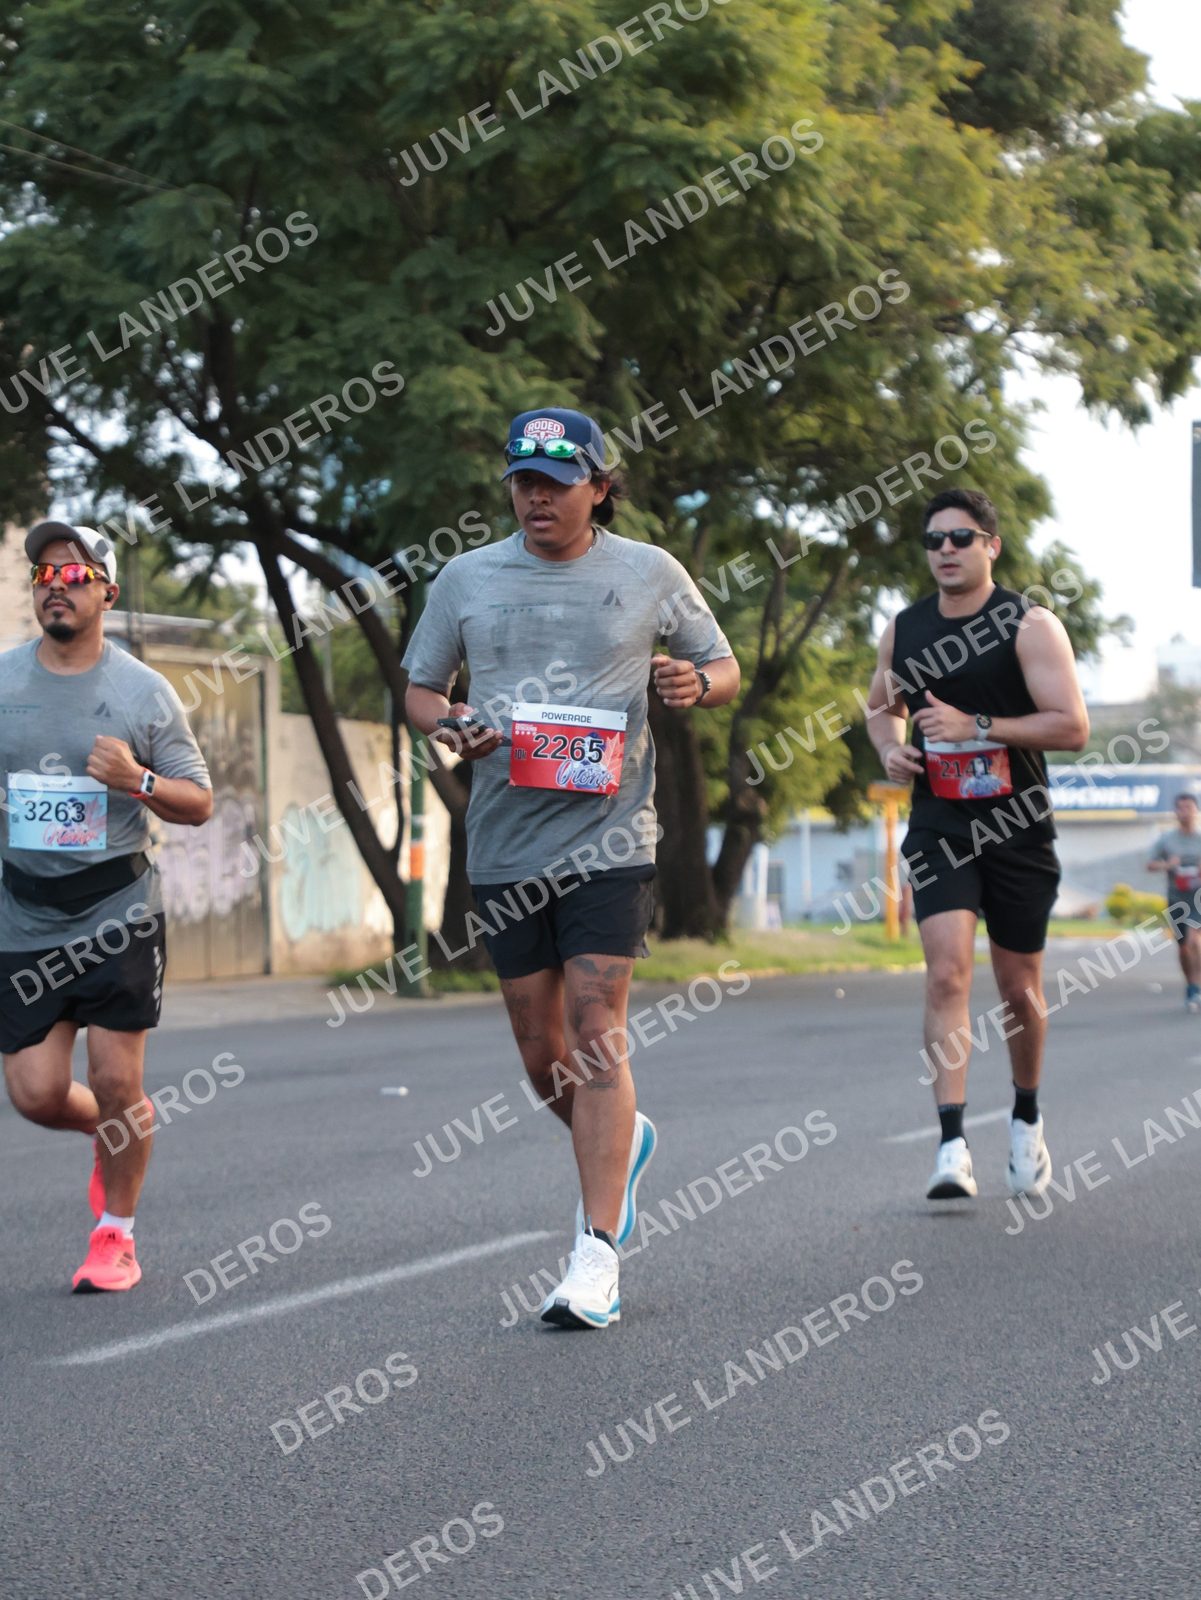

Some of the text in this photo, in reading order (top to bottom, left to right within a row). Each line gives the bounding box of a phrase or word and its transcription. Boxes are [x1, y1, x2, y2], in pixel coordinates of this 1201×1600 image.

[541, 711, 592, 724] POWERADE
[532, 733, 604, 764] 2265
[940, 759, 989, 779] 2141
[23, 800, 87, 823] 3263
